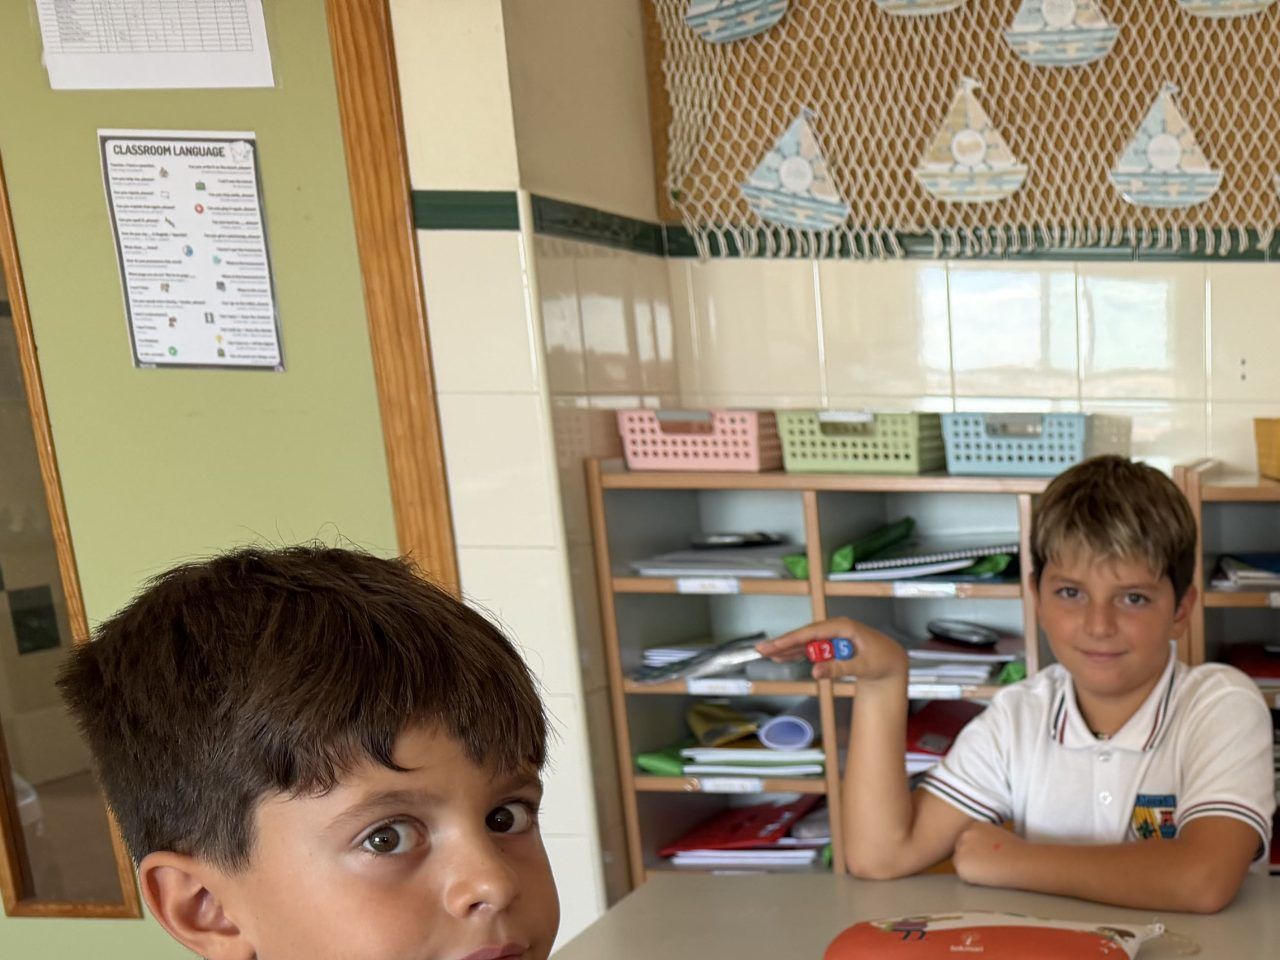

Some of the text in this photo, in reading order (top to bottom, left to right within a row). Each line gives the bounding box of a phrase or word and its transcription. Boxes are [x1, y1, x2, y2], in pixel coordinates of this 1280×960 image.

[113, 144, 225, 158] CLASSROOM LANGUAGE
[821, 643, 832, 659] 2
[839, 640, 849, 657] 5
